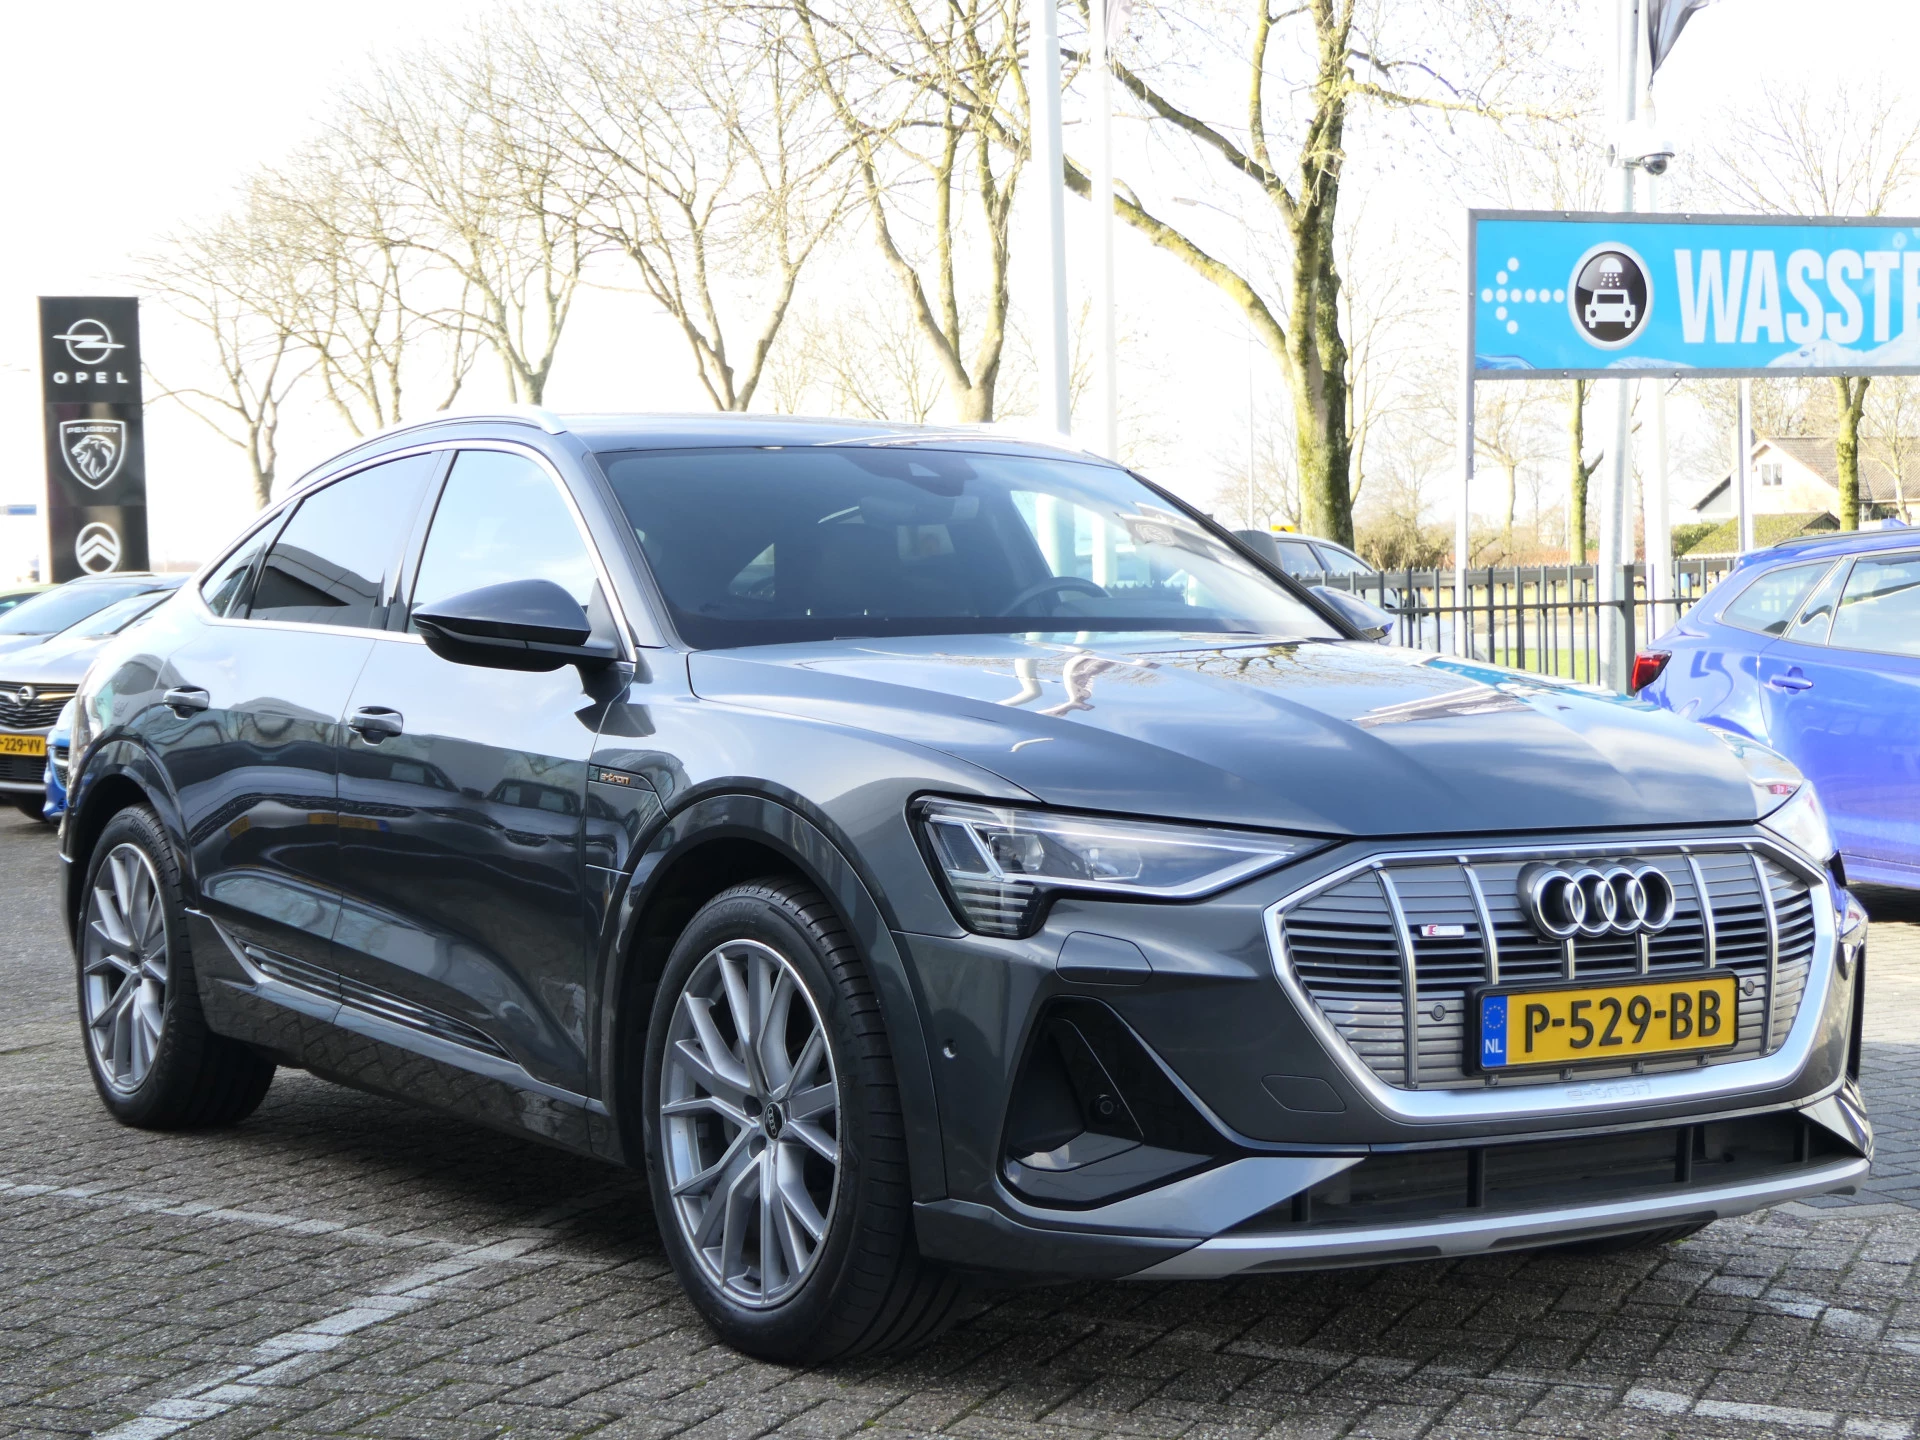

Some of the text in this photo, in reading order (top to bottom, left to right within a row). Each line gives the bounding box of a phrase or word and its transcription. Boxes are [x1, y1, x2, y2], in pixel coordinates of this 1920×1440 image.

[53, 371, 128, 384] OPEL
[66, 426, 119, 434] PEUGEOT
[1524, 989, 1721, 1053] P-529-BB
[1485, 1037, 1503, 1055] NL
